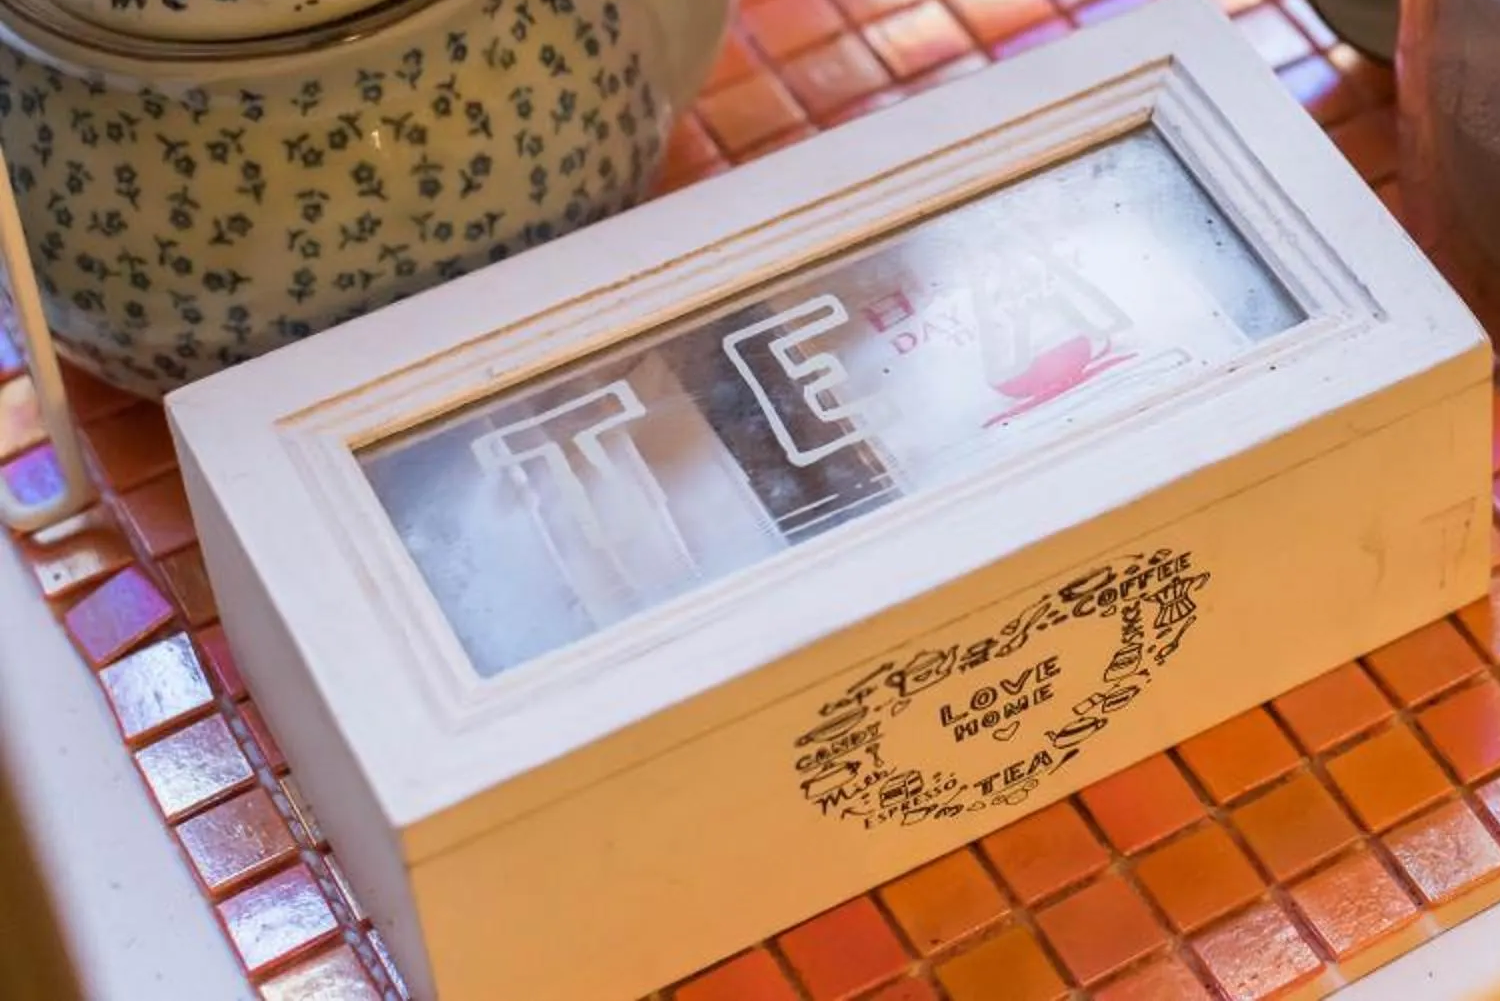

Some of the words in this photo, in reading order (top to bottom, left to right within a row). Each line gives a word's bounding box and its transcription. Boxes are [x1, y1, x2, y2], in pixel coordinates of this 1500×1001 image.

[1071, 551, 1193, 618] COFFEE
[939, 655, 1062, 728] LOVE
[953, 682, 1055, 743] HOME
[794, 720, 883, 770] CANDY
[973, 750, 1054, 796] TEA
[863, 777, 958, 830] ESPRESSO
